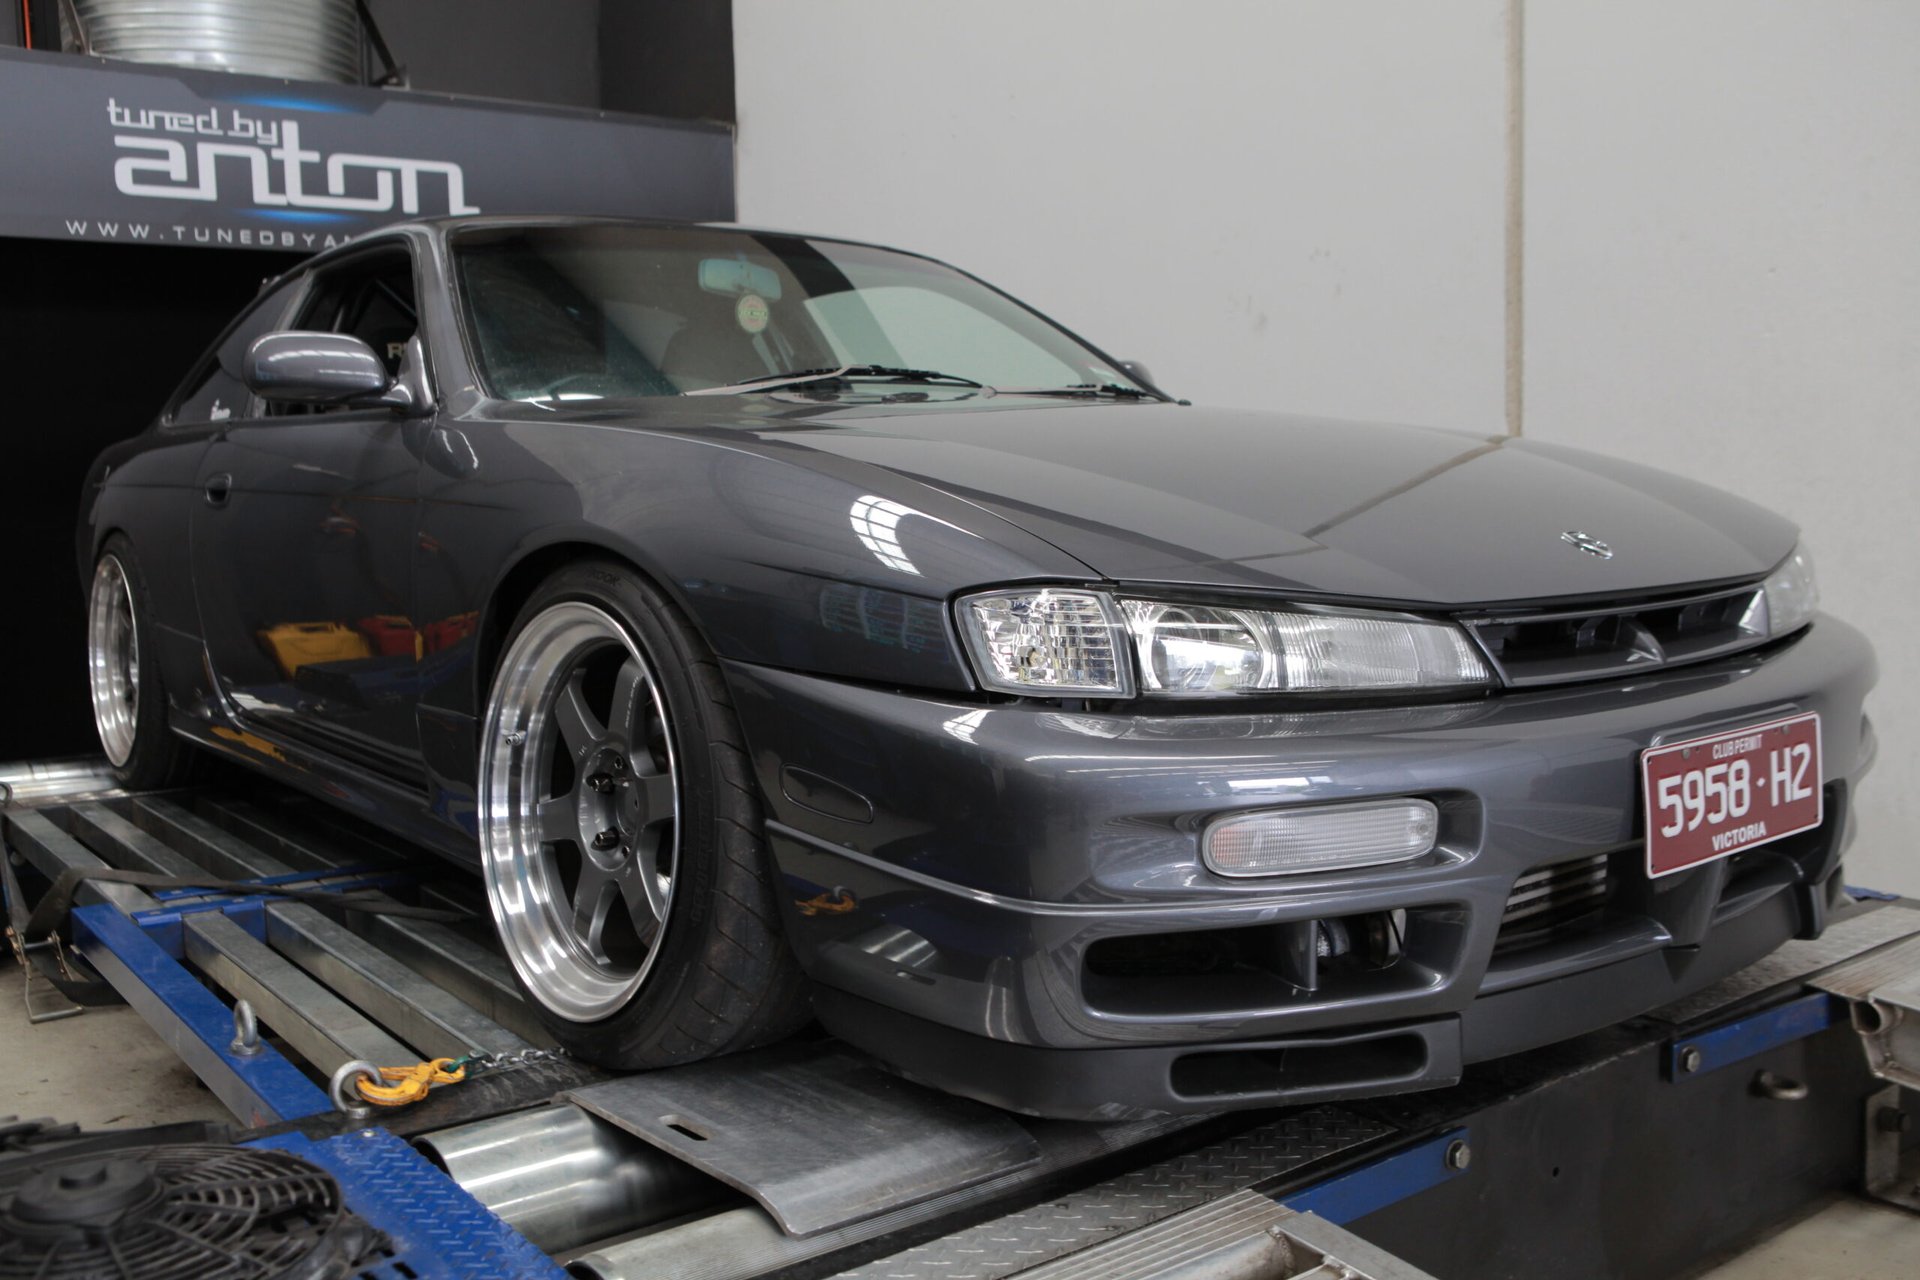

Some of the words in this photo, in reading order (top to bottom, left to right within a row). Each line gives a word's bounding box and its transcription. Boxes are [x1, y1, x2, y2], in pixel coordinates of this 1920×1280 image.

[107, 98, 223, 136] tuned
[227, 109, 279, 145] by
[114, 120, 481, 216] anton
[1712, 741, 1734, 760] CLUB
[1711, 821, 1767, 851] VICTORIA
